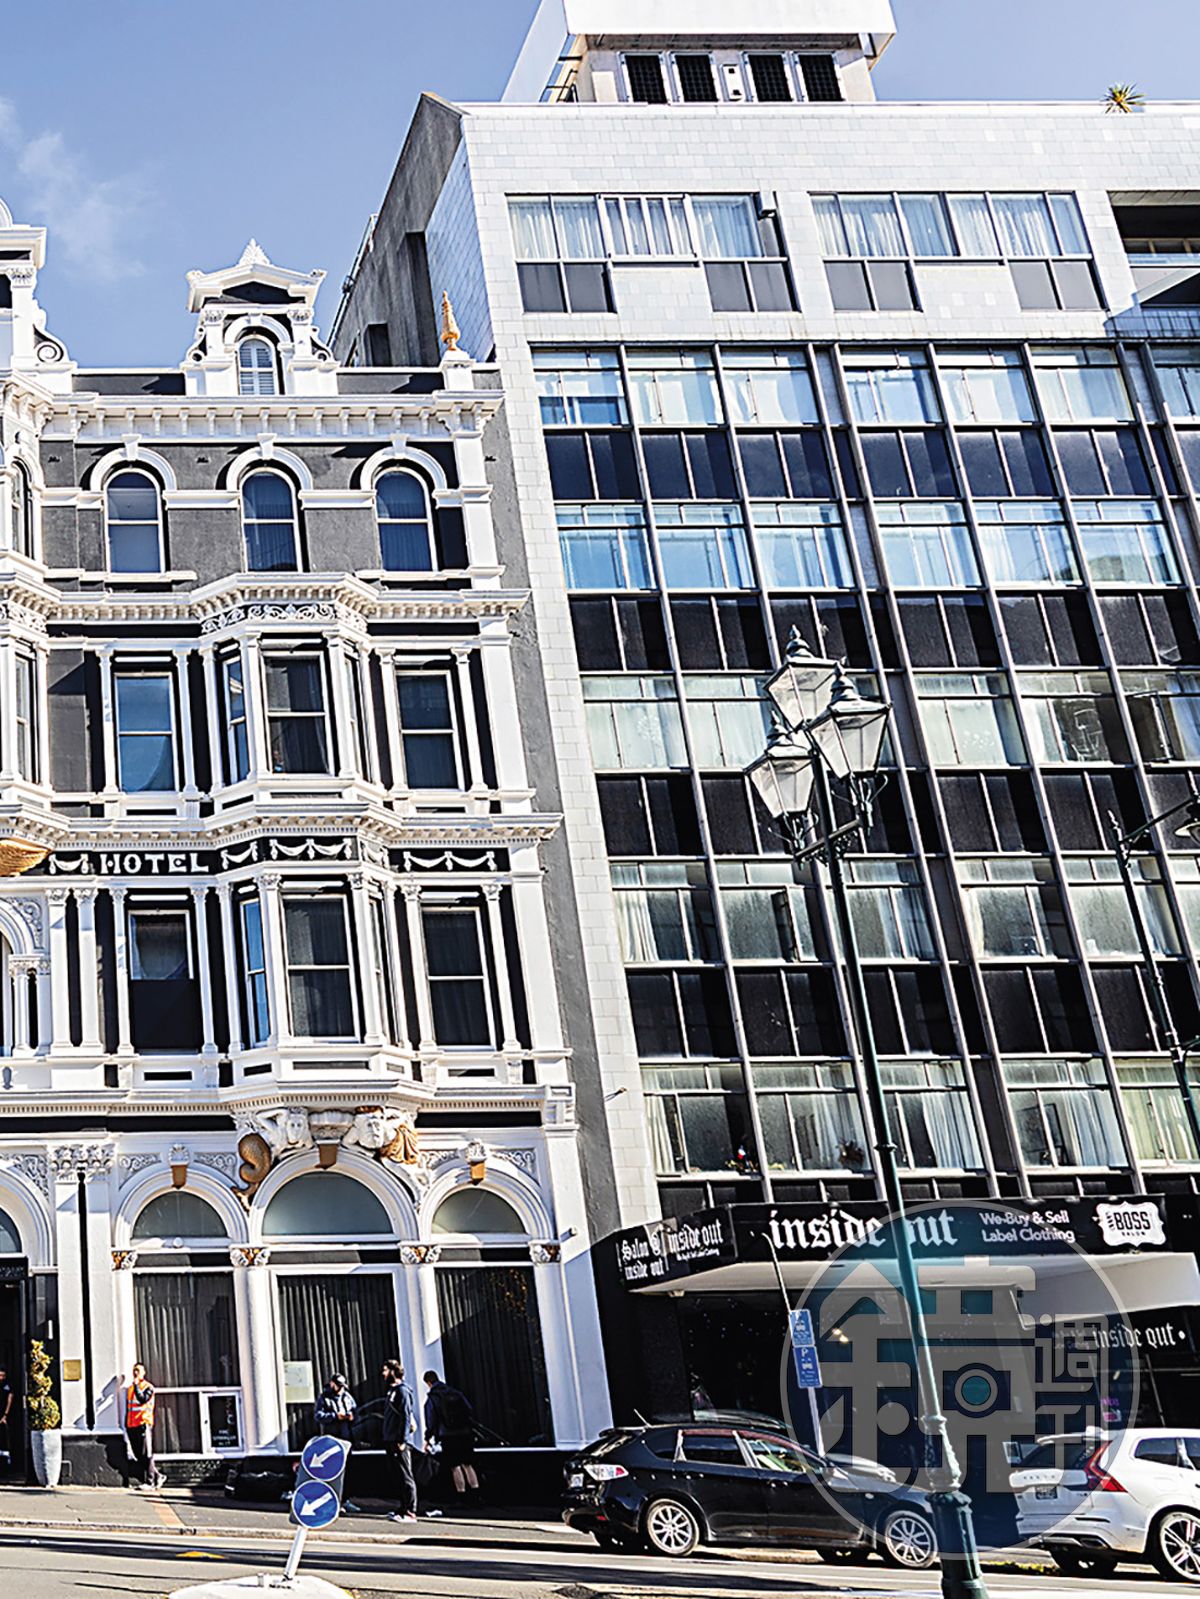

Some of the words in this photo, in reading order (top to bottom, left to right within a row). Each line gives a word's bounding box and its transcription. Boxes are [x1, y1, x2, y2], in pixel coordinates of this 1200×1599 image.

[100, 853, 209, 874] HOTEL
[1032, 1211, 1044, 1224] &
[1045, 1209, 1070, 1224] Sell
[1113, 1211, 1151, 1231] BOSS
[668, 1224, 701, 1253] inside
[701, 1218, 724, 1247] out
[769, 1209, 886, 1249] inside
[981, 1229, 1018, 1243] Label
[1020, 1227, 1076, 1244] Clothing
[1092, 1323, 1142, 1349] inside
